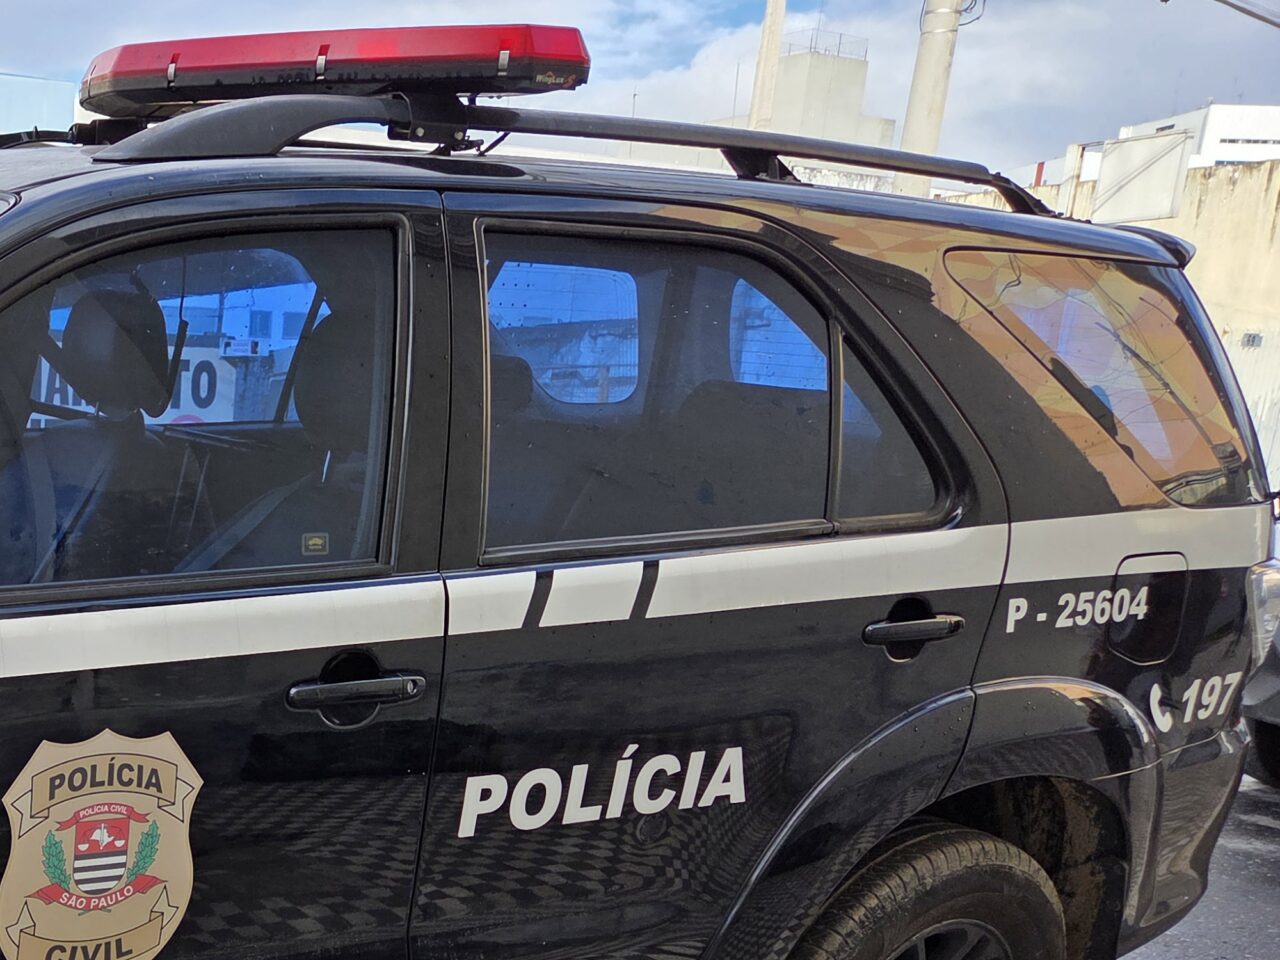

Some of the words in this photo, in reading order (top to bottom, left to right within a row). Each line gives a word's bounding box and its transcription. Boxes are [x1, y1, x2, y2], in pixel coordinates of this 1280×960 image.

[1006, 597, 1028, 634] P
[1055, 586, 1149, 629] 25604
[1181, 671, 1243, 724] 197
[48, 757, 163, 802] POLÍCIA
[458, 743, 746, 839] POLÍCIA
[110, 804, 128, 814] CIVIL
[89, 886, 134, 910] PAULO
